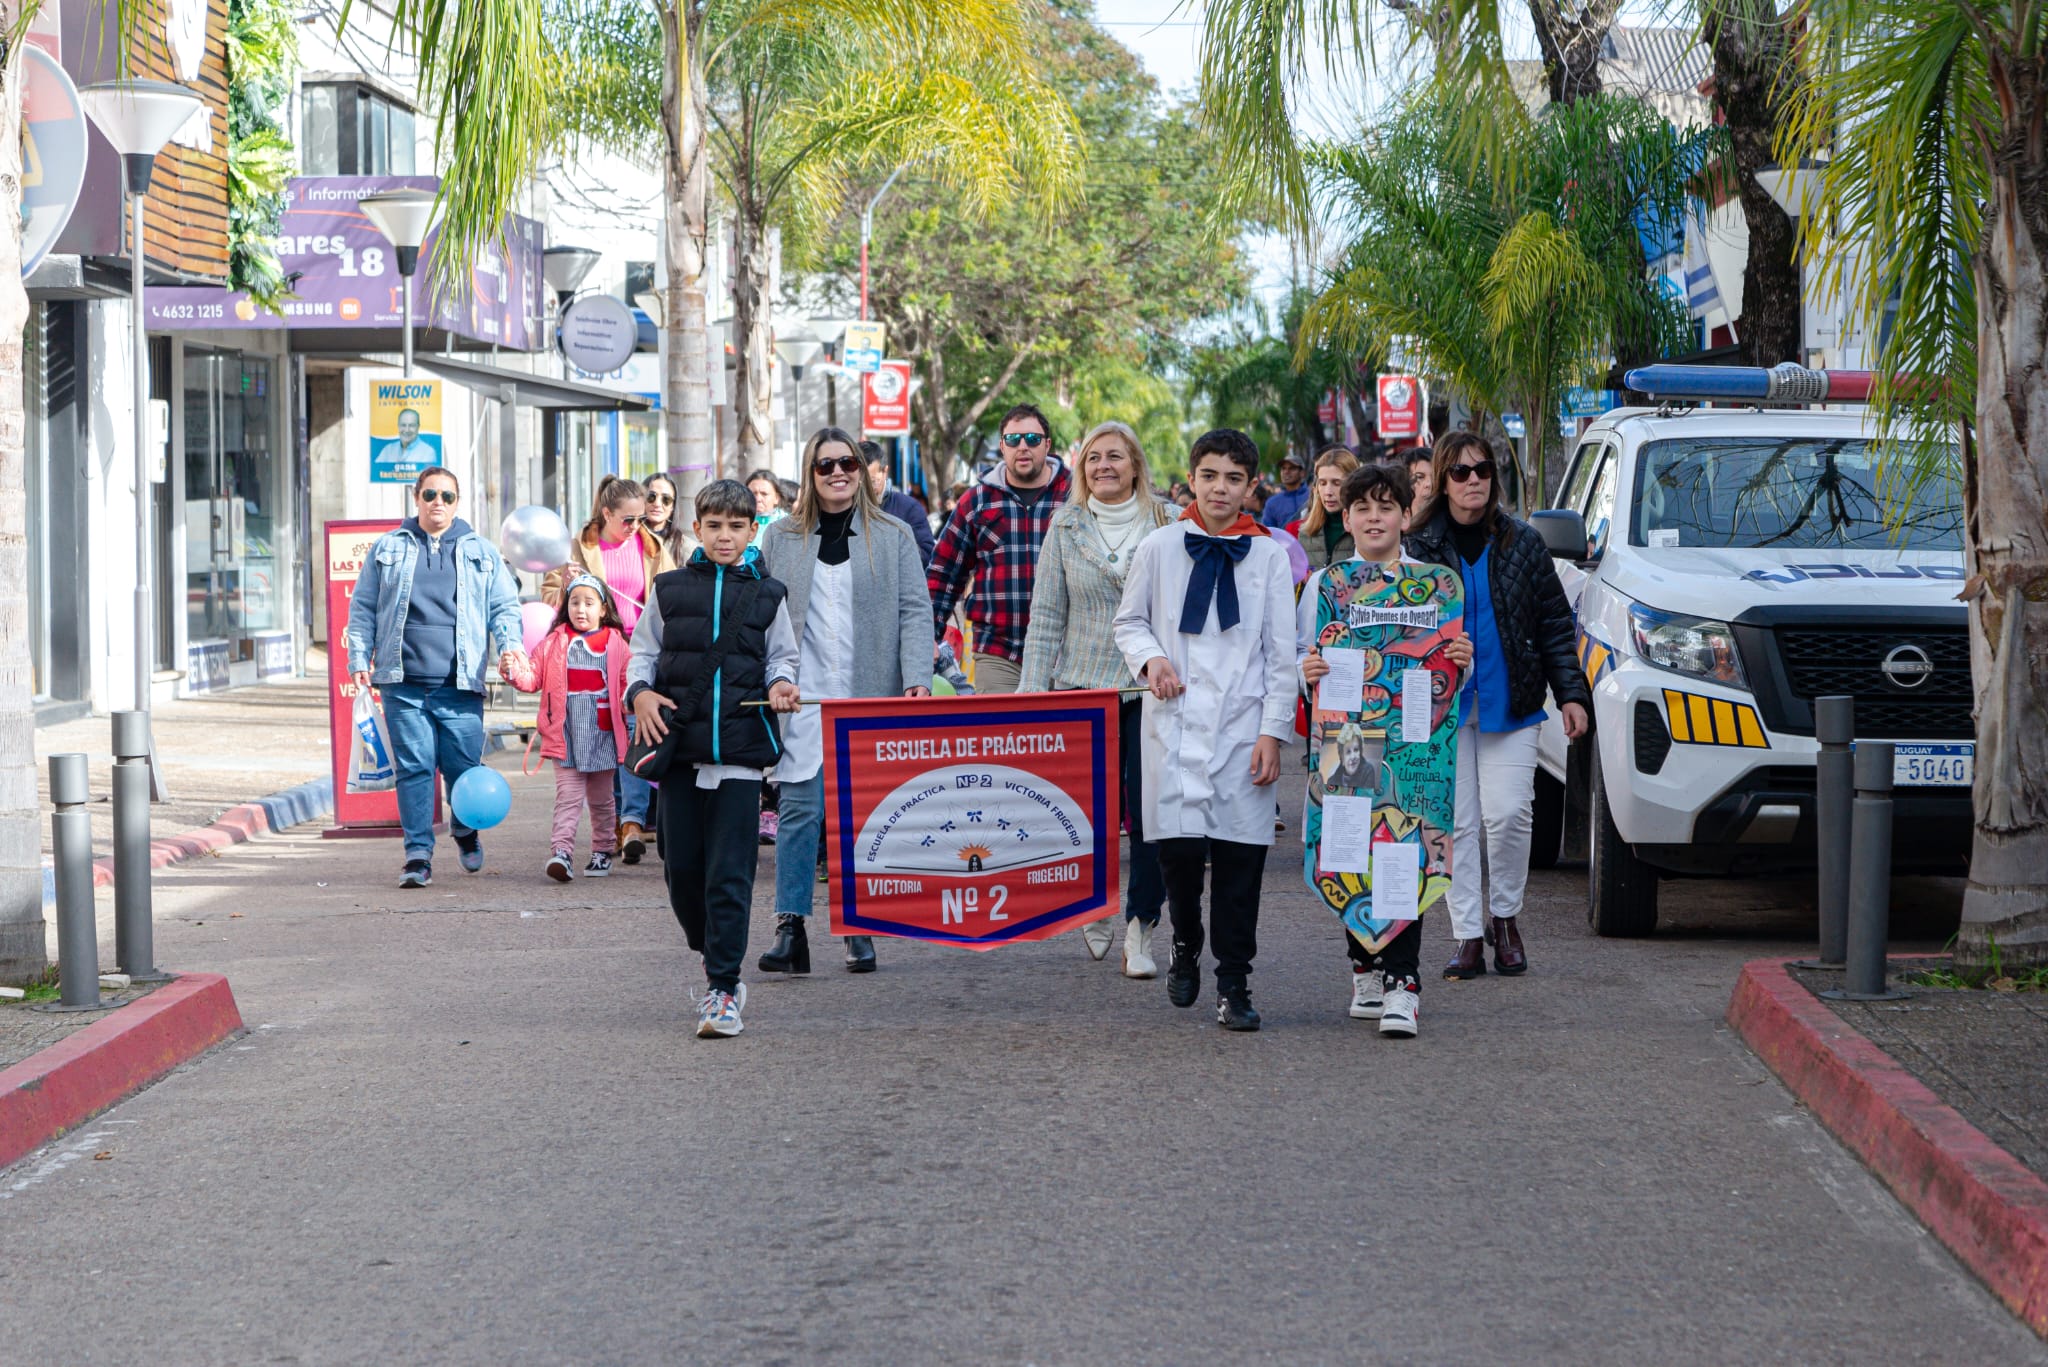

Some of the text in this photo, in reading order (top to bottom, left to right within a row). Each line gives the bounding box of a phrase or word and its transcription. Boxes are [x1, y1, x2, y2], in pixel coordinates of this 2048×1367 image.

[308, 186, 384, 201] Informáti
[276, 235, 345, 255] ares
[338, 247, 385, 277] 18
[162, 304, 223, 319] 4632 1215
[265, 302, 333, 315] SMSUNG
[378, 385, 432, 399] WILSON
[333, 561, 353, 571] LAS
[1371, 609, 1398, 623] Puentes
[1400, 611, 1408, 623] de
[1409, 606, 1437, 627] Oyenard
[1883, 663, 1933, 672] NISSAN
[876, 732, 1066, 762] ESCUELA DE PRÁCTICA
[1894, 747, 1933, 755] RUGUAY
[1909, 758, 1964, 780] 5040
[867, 824, 891, 862] ESCUELA
[888, 810, 902, 824] DE
[900, 784, 946, 812] PRÁCTICA
[980, 774, 992, 788] 2
[1005, 781, 1051, 808] VICTORIA
[1050, 806, 1081, 847] FRIGERIO
[867, 863, 1079, 897] VICTORIA FRIGERIO
[989, 884, 1009, 921] 2
